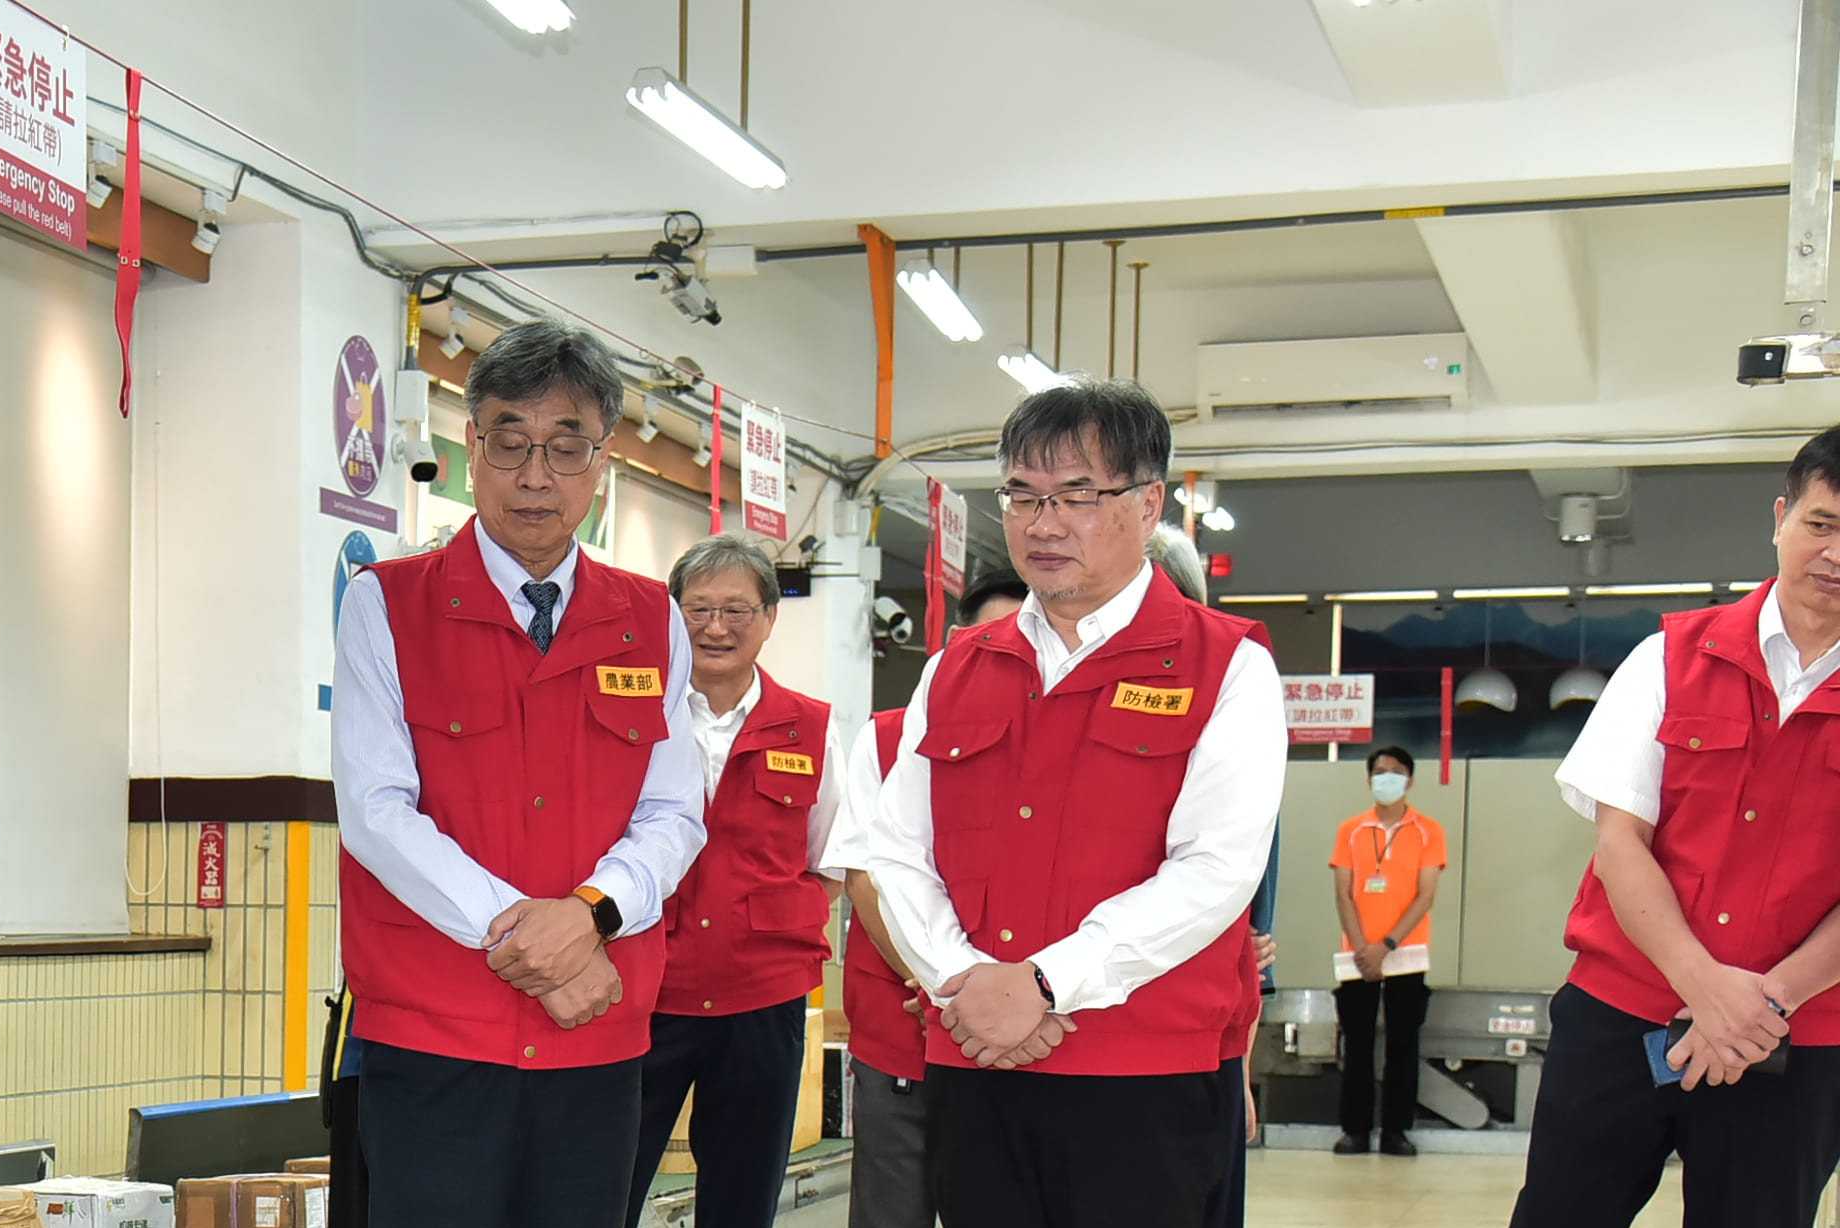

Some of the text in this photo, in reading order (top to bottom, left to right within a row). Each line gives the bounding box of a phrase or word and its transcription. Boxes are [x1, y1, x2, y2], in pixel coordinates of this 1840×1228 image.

[48, 179, 75, 215] Stop
[13, 196, 27, 220] pull
[28, 201, 40, 223] the
[41, 208, 54, 230] red
[55, 214, 72, 242] belt)
[605, 672, 653, 691] 農業部
[1122, 690, 1182, 710] 防檢署
[772, 756, 807, 771] 防檢署
